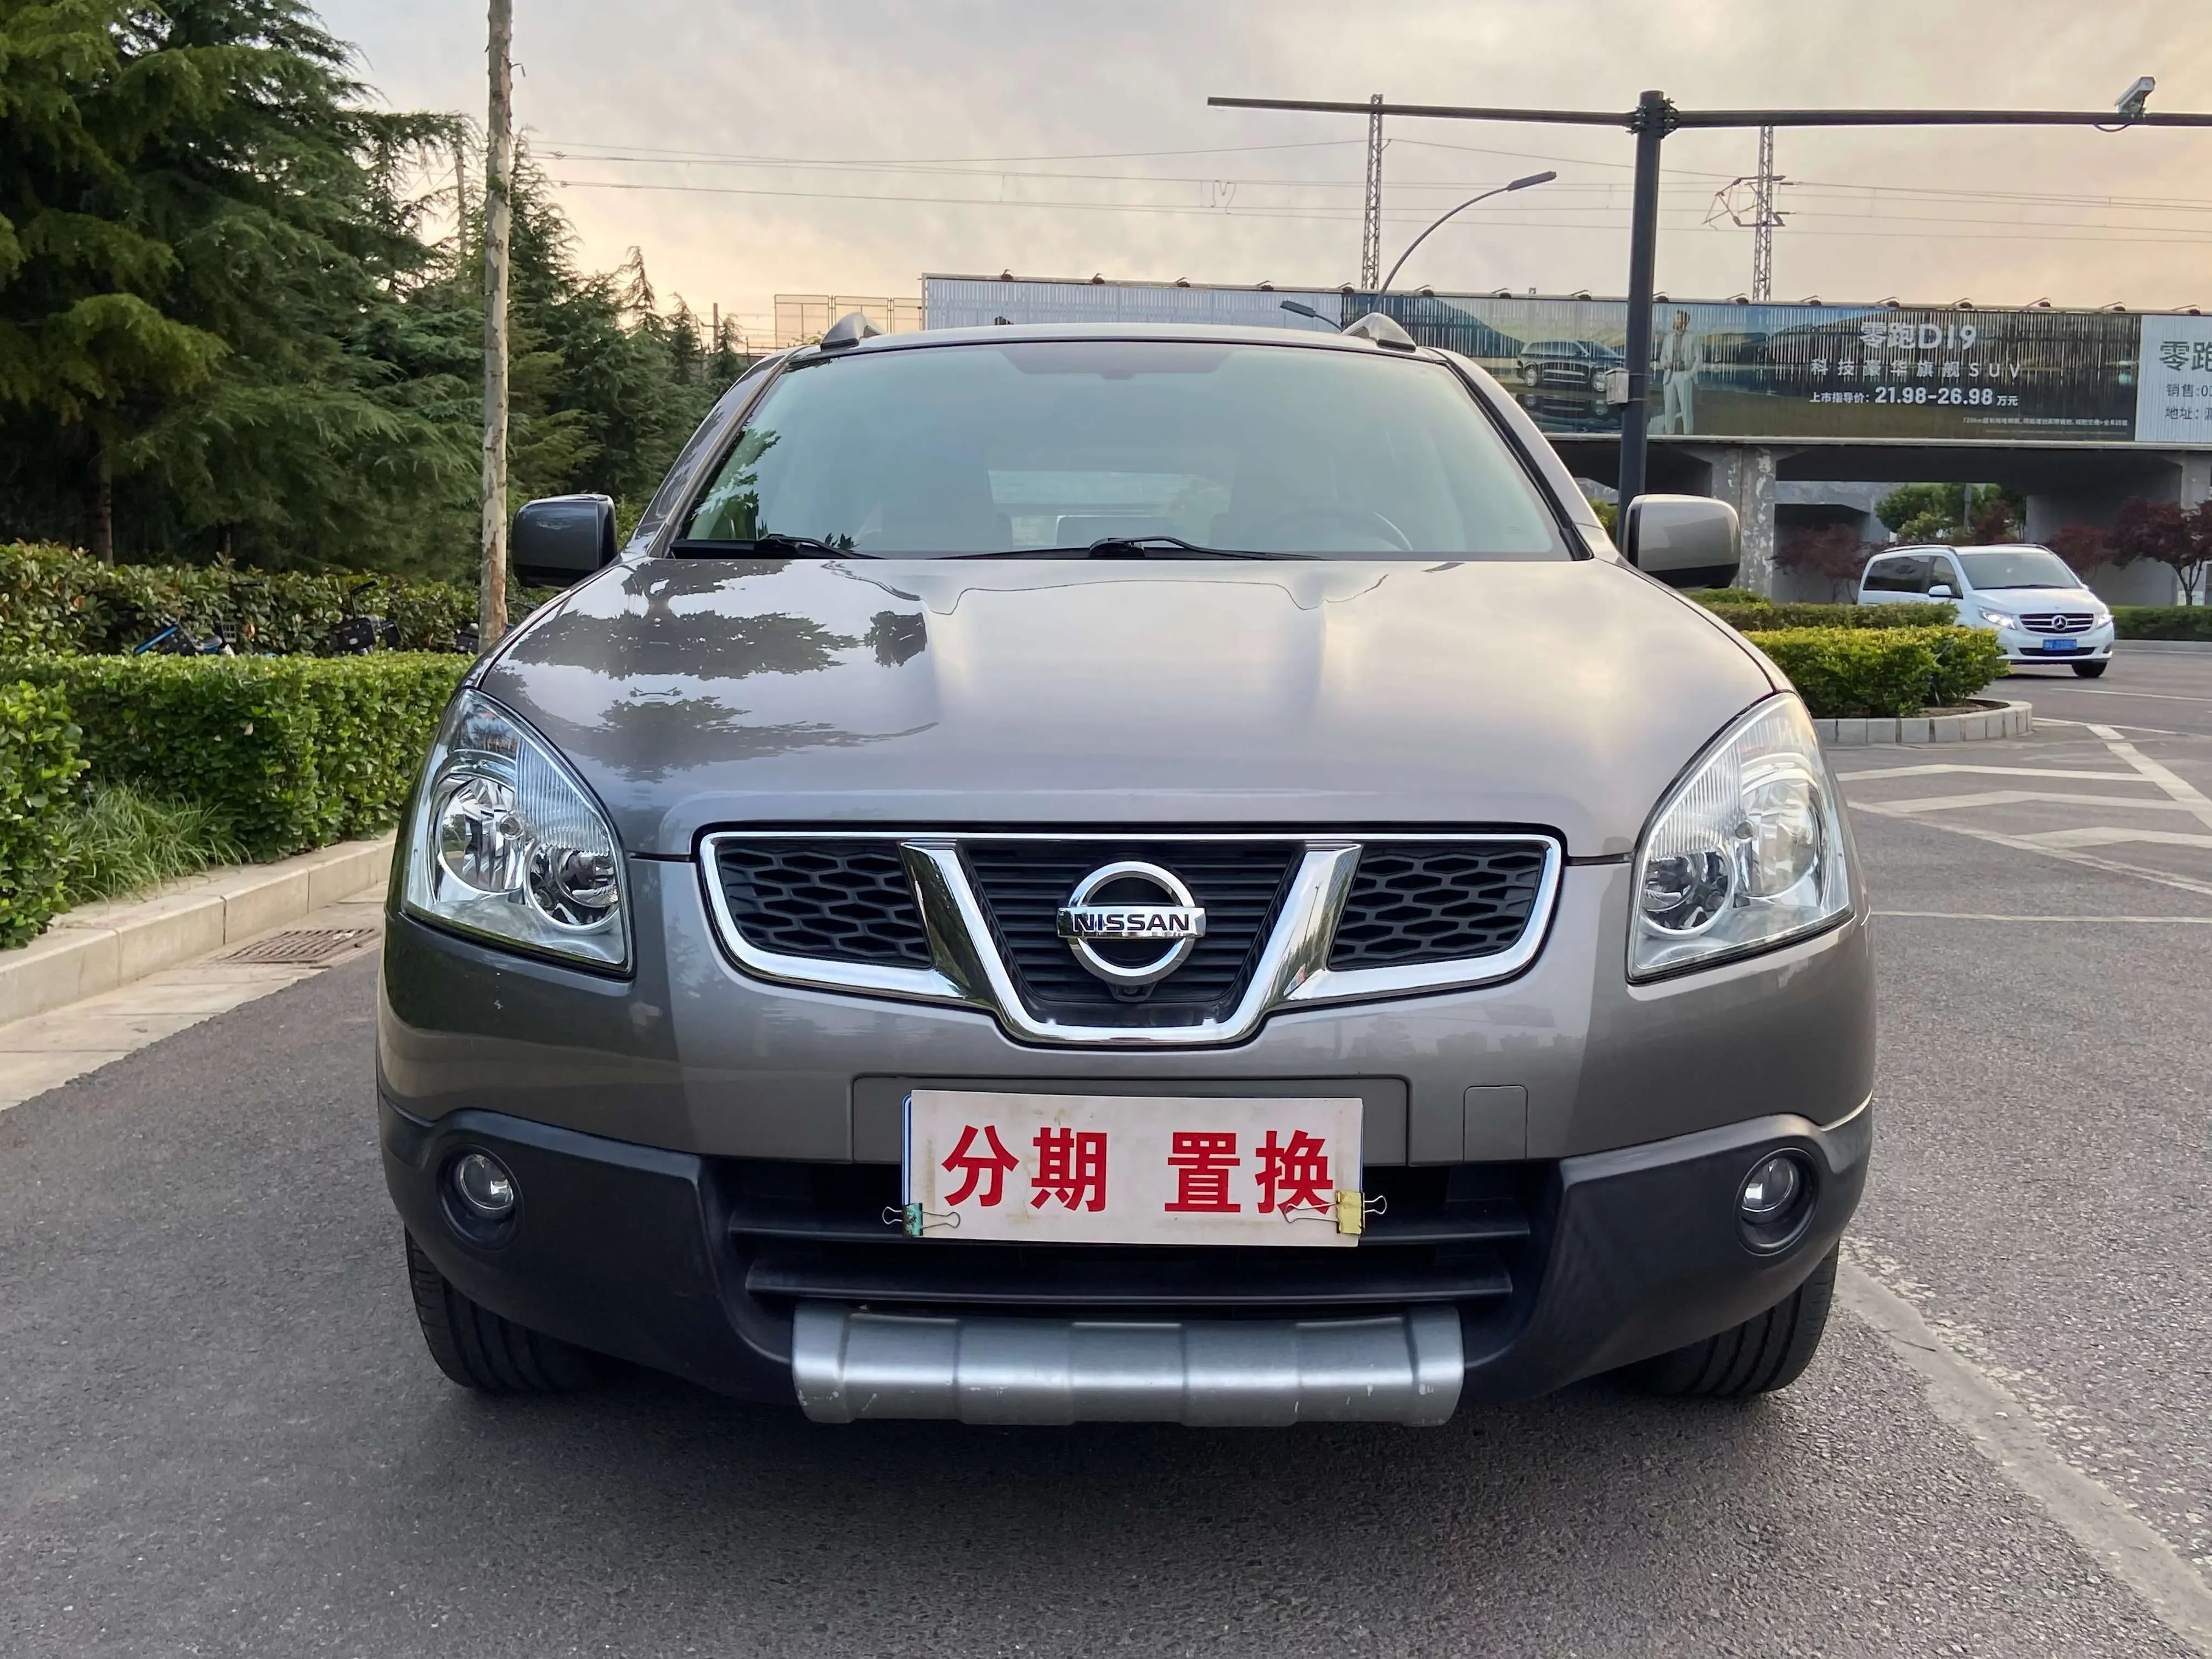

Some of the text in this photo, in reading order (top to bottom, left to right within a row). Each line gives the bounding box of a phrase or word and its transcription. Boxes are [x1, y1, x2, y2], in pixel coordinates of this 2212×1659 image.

[1874, 386, 1993, 405] 21.98-26.98
[1073, 913, 1190, 931] NISSAN
[941, 1125, 1334, 1215] 分期 置换
